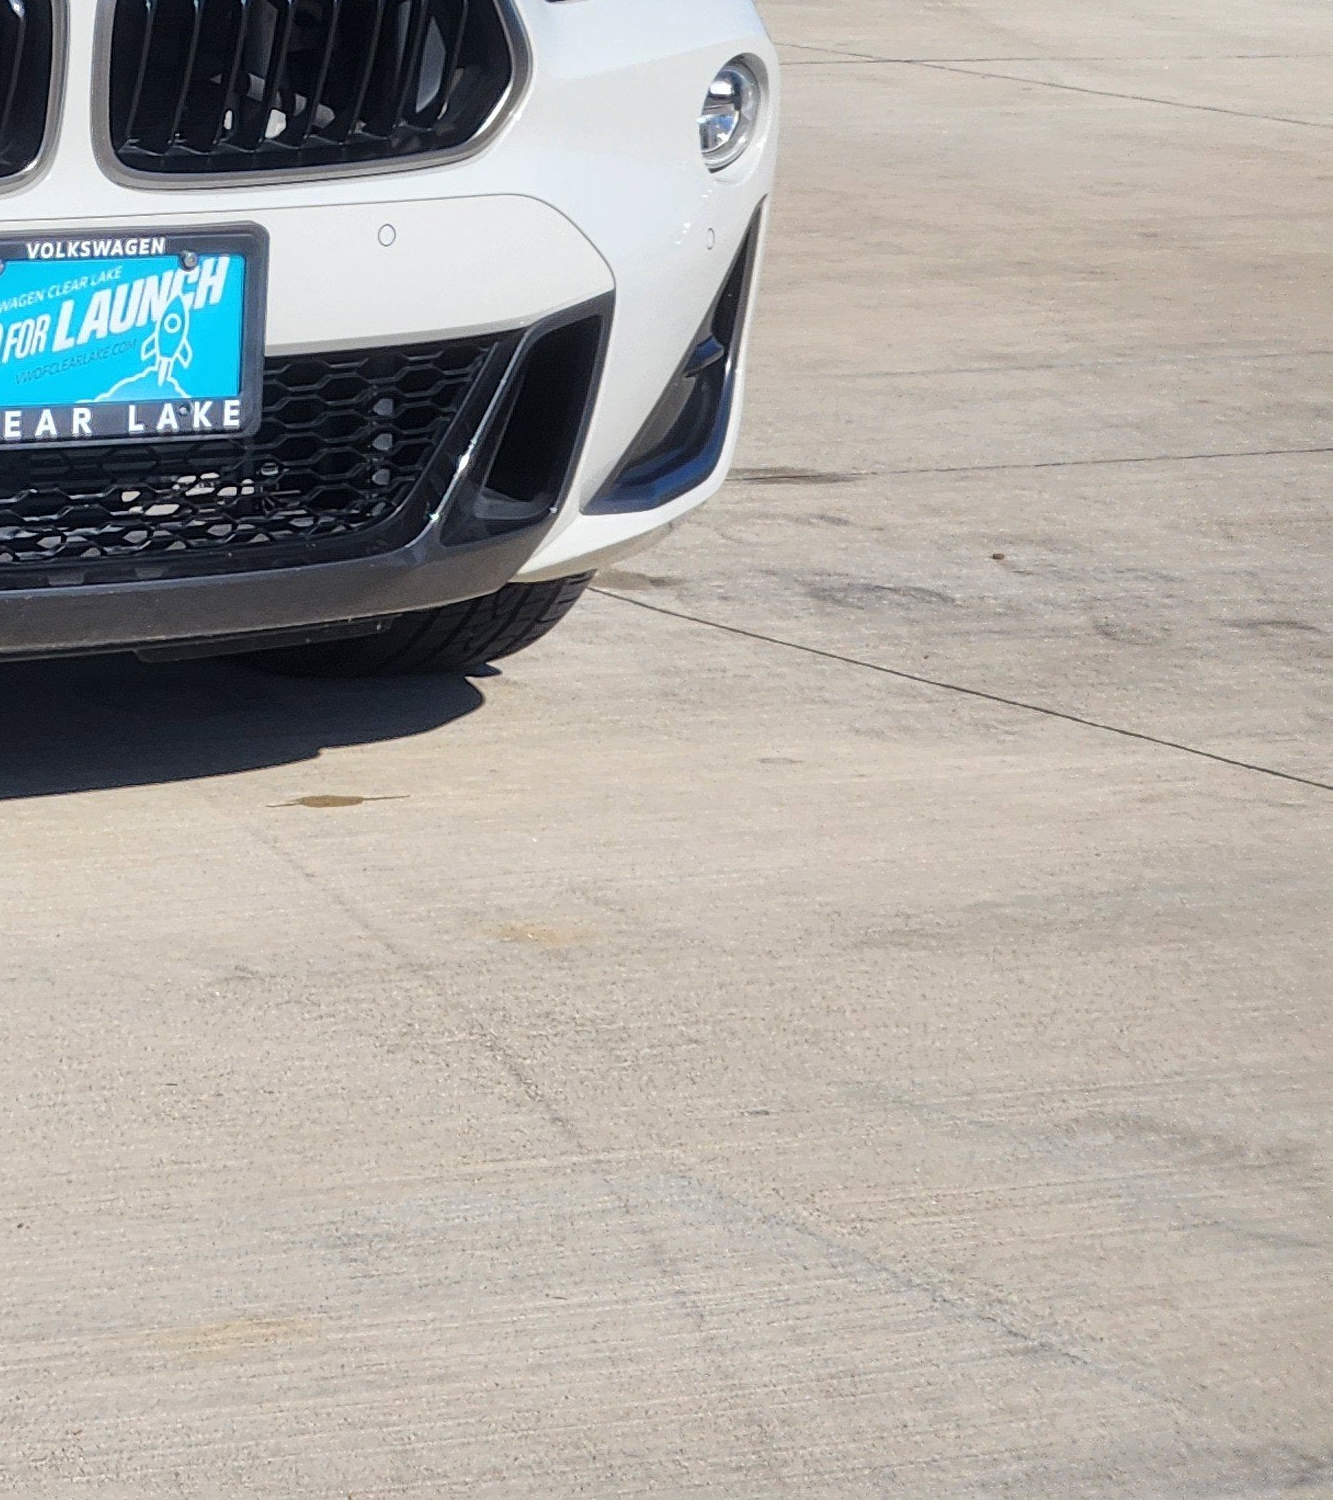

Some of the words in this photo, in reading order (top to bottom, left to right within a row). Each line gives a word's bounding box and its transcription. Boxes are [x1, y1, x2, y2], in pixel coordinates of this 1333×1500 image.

[26, 237, 166, 260] VOLKSWAGEN
[47, 275, 90, 299] CLEAR
[90, 265, 123, 287] LAKE
[2, 314, 51, 364] FOR
[52, 254, 231, 352] LAUNCH
[128, 400, 241, 435] LAKE
